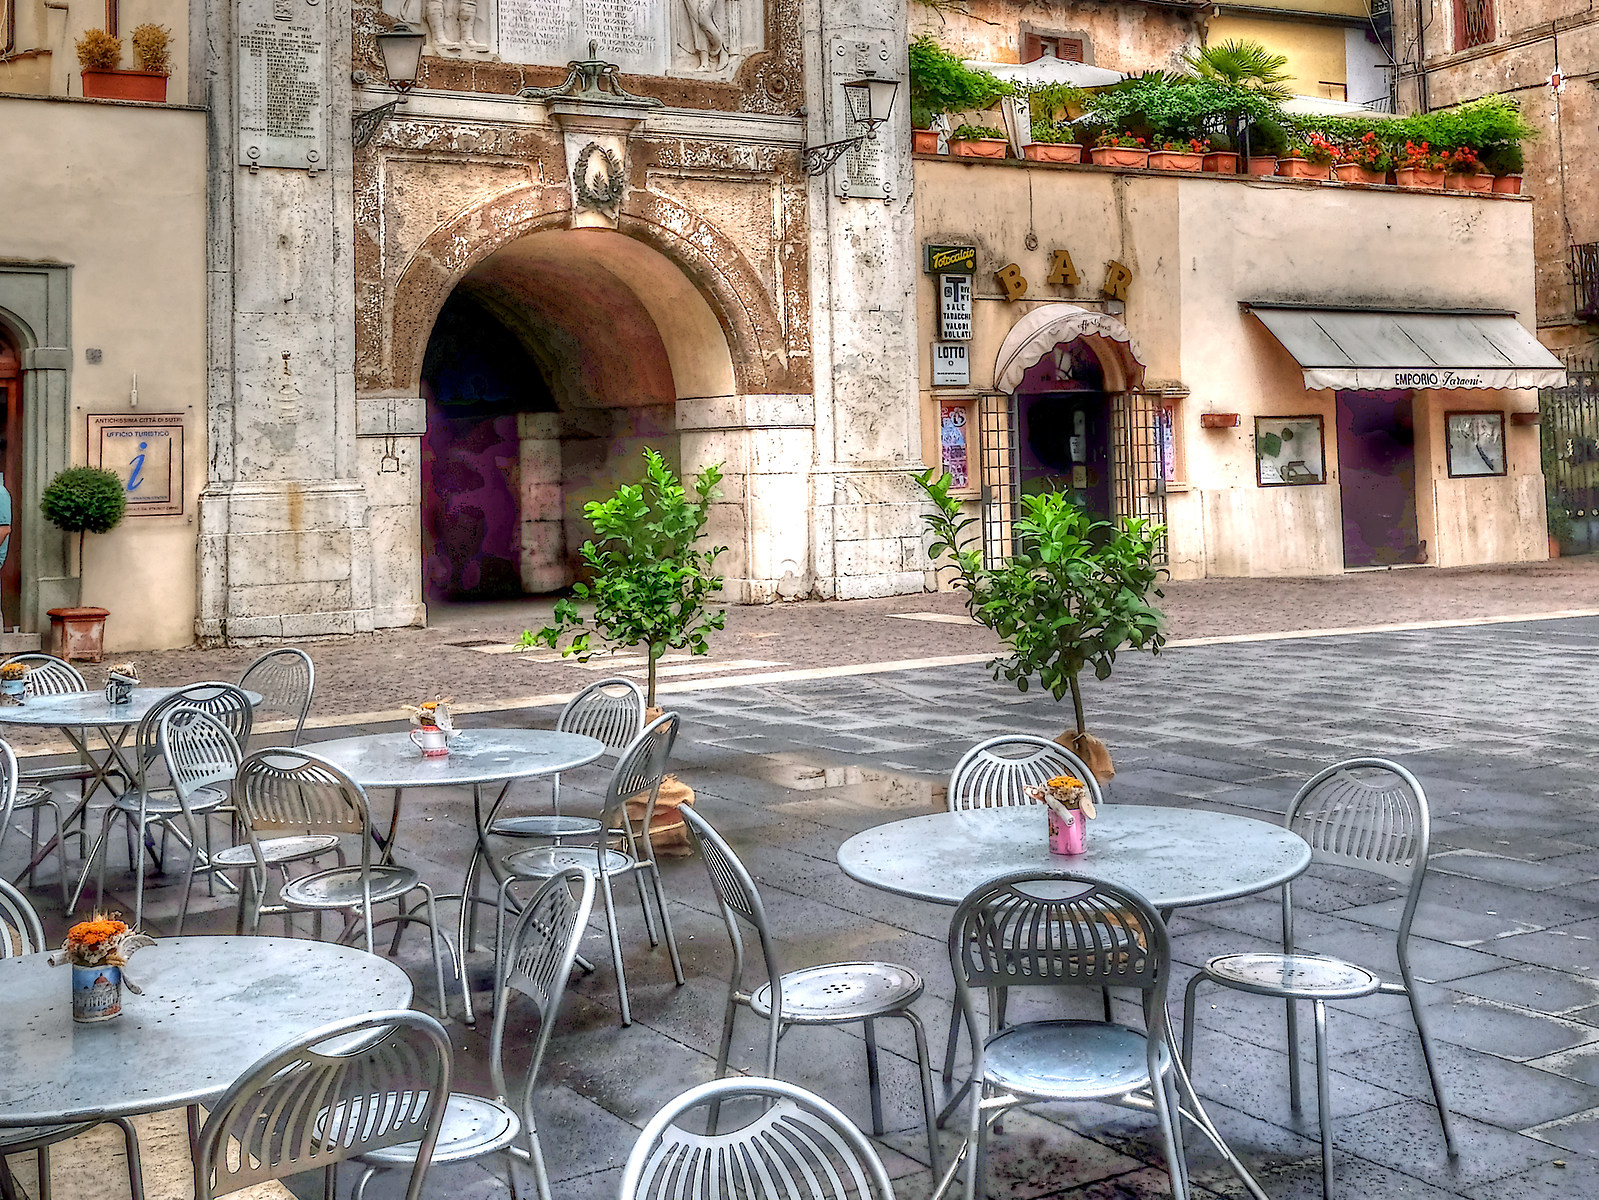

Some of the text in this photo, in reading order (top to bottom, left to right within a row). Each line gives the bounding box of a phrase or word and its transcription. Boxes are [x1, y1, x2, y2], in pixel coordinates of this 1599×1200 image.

[932, 247, 975, 270] Totocalcio
[995, 250, 1133, 302] BAR
[945, 277, 966, 302] T
[943, 312, 971, 320] TABACCHI
[946, 322, 969, 330] VALORI
[944, 331, 971, 339] BOLLATI
[938, 346, 965, 359] LOTTO
[1395, 373, 1438, 385] EMPORIO
